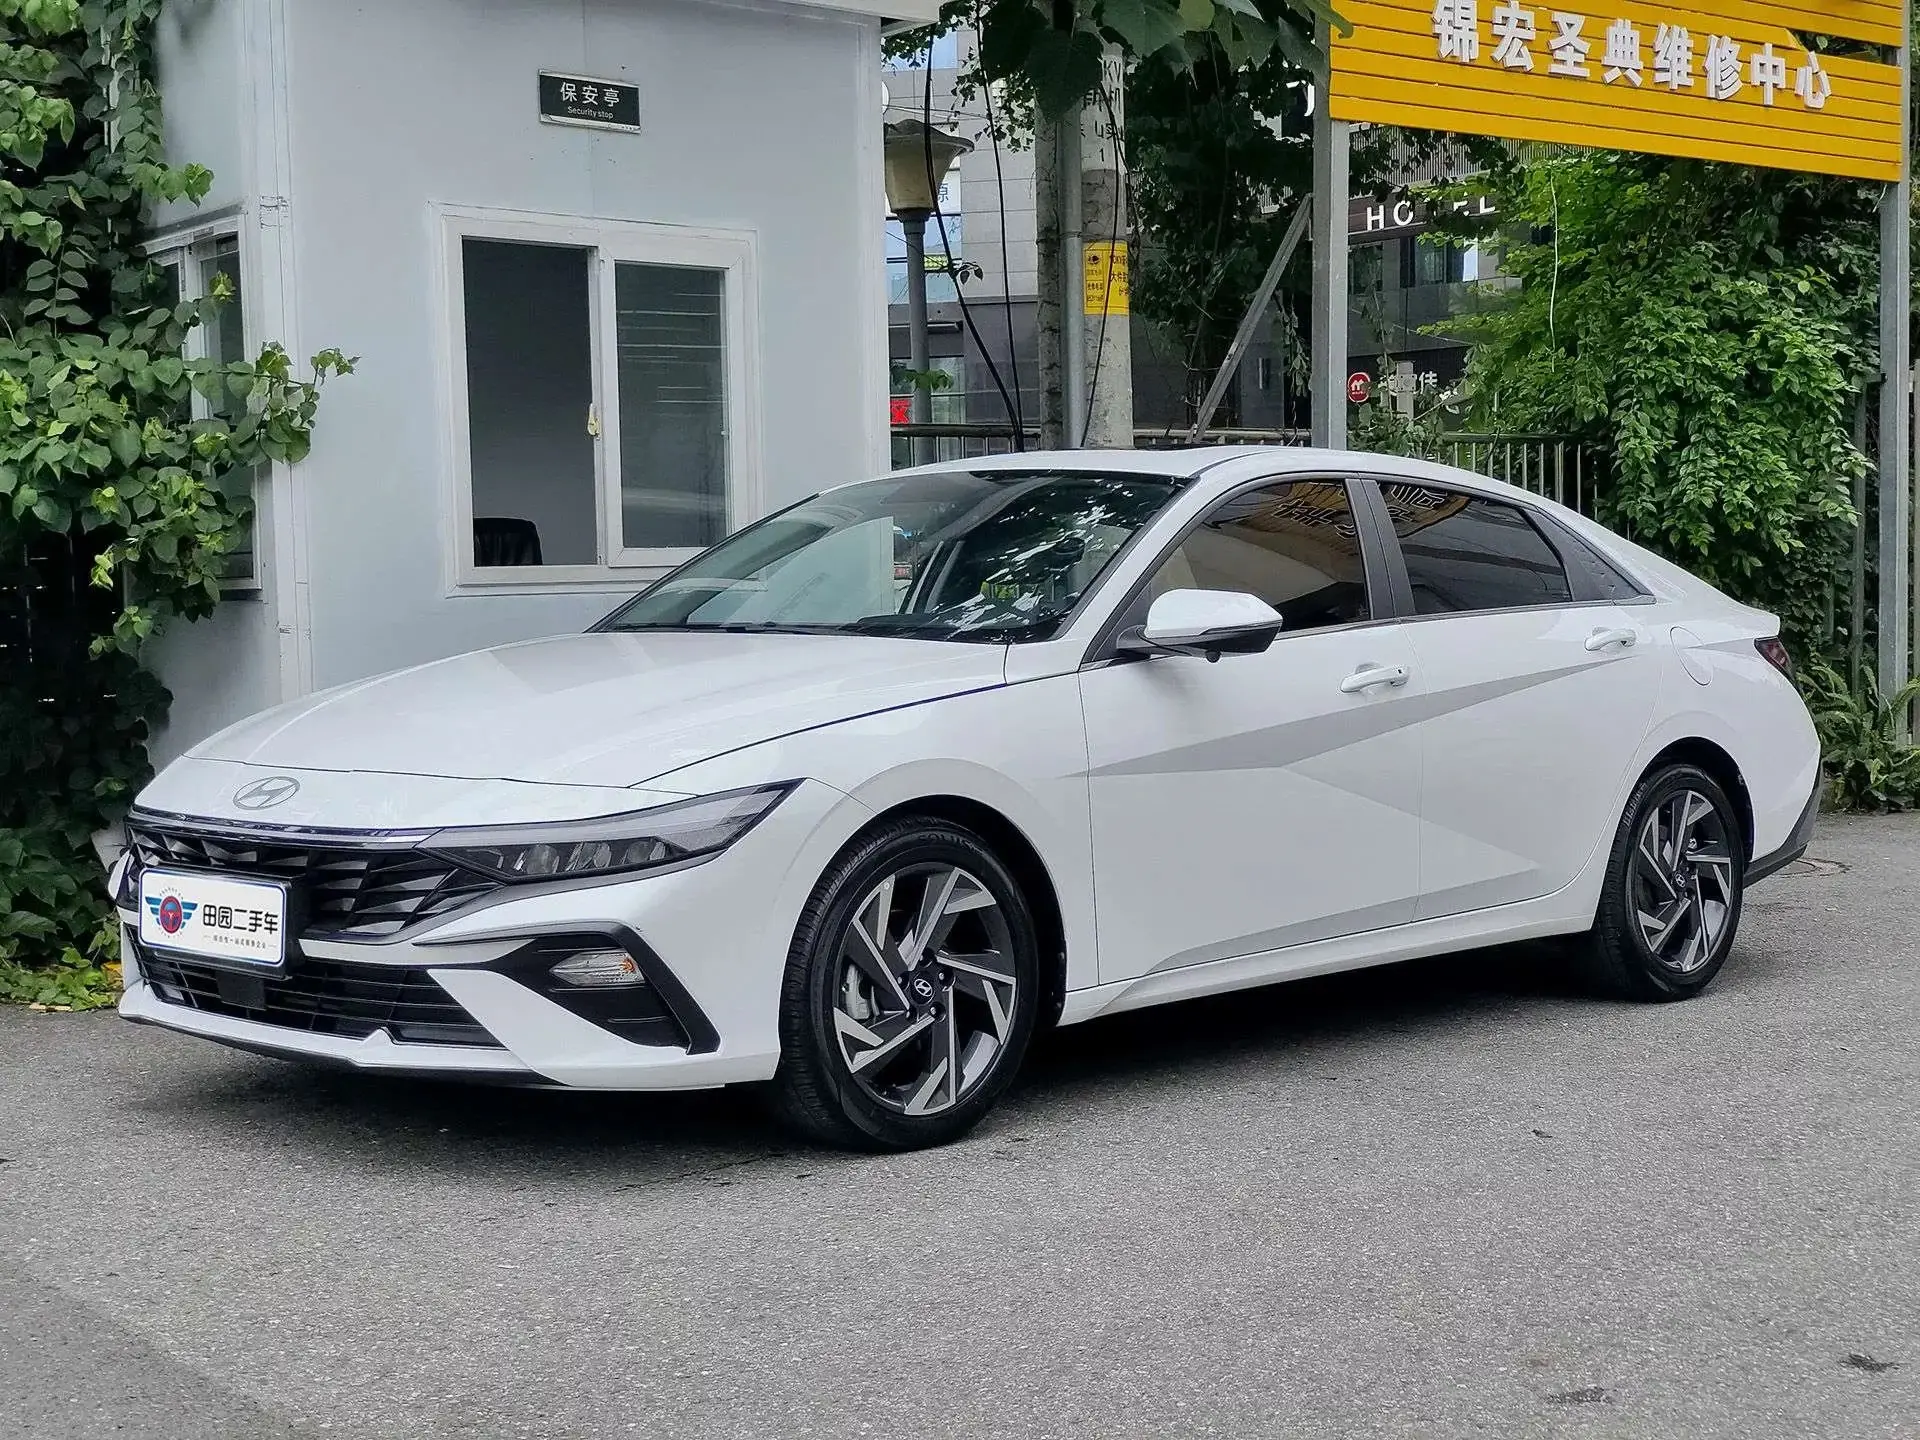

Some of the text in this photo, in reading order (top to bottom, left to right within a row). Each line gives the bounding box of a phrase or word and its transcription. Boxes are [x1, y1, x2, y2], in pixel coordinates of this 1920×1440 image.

[1432, 0, 1832, 109] 锦宏圣典维修中心
[560, 82, 620, 107] 保安亭
[567, 106, 614, 120] Security stop
[203, 904, 279, 935] 田园二手车
